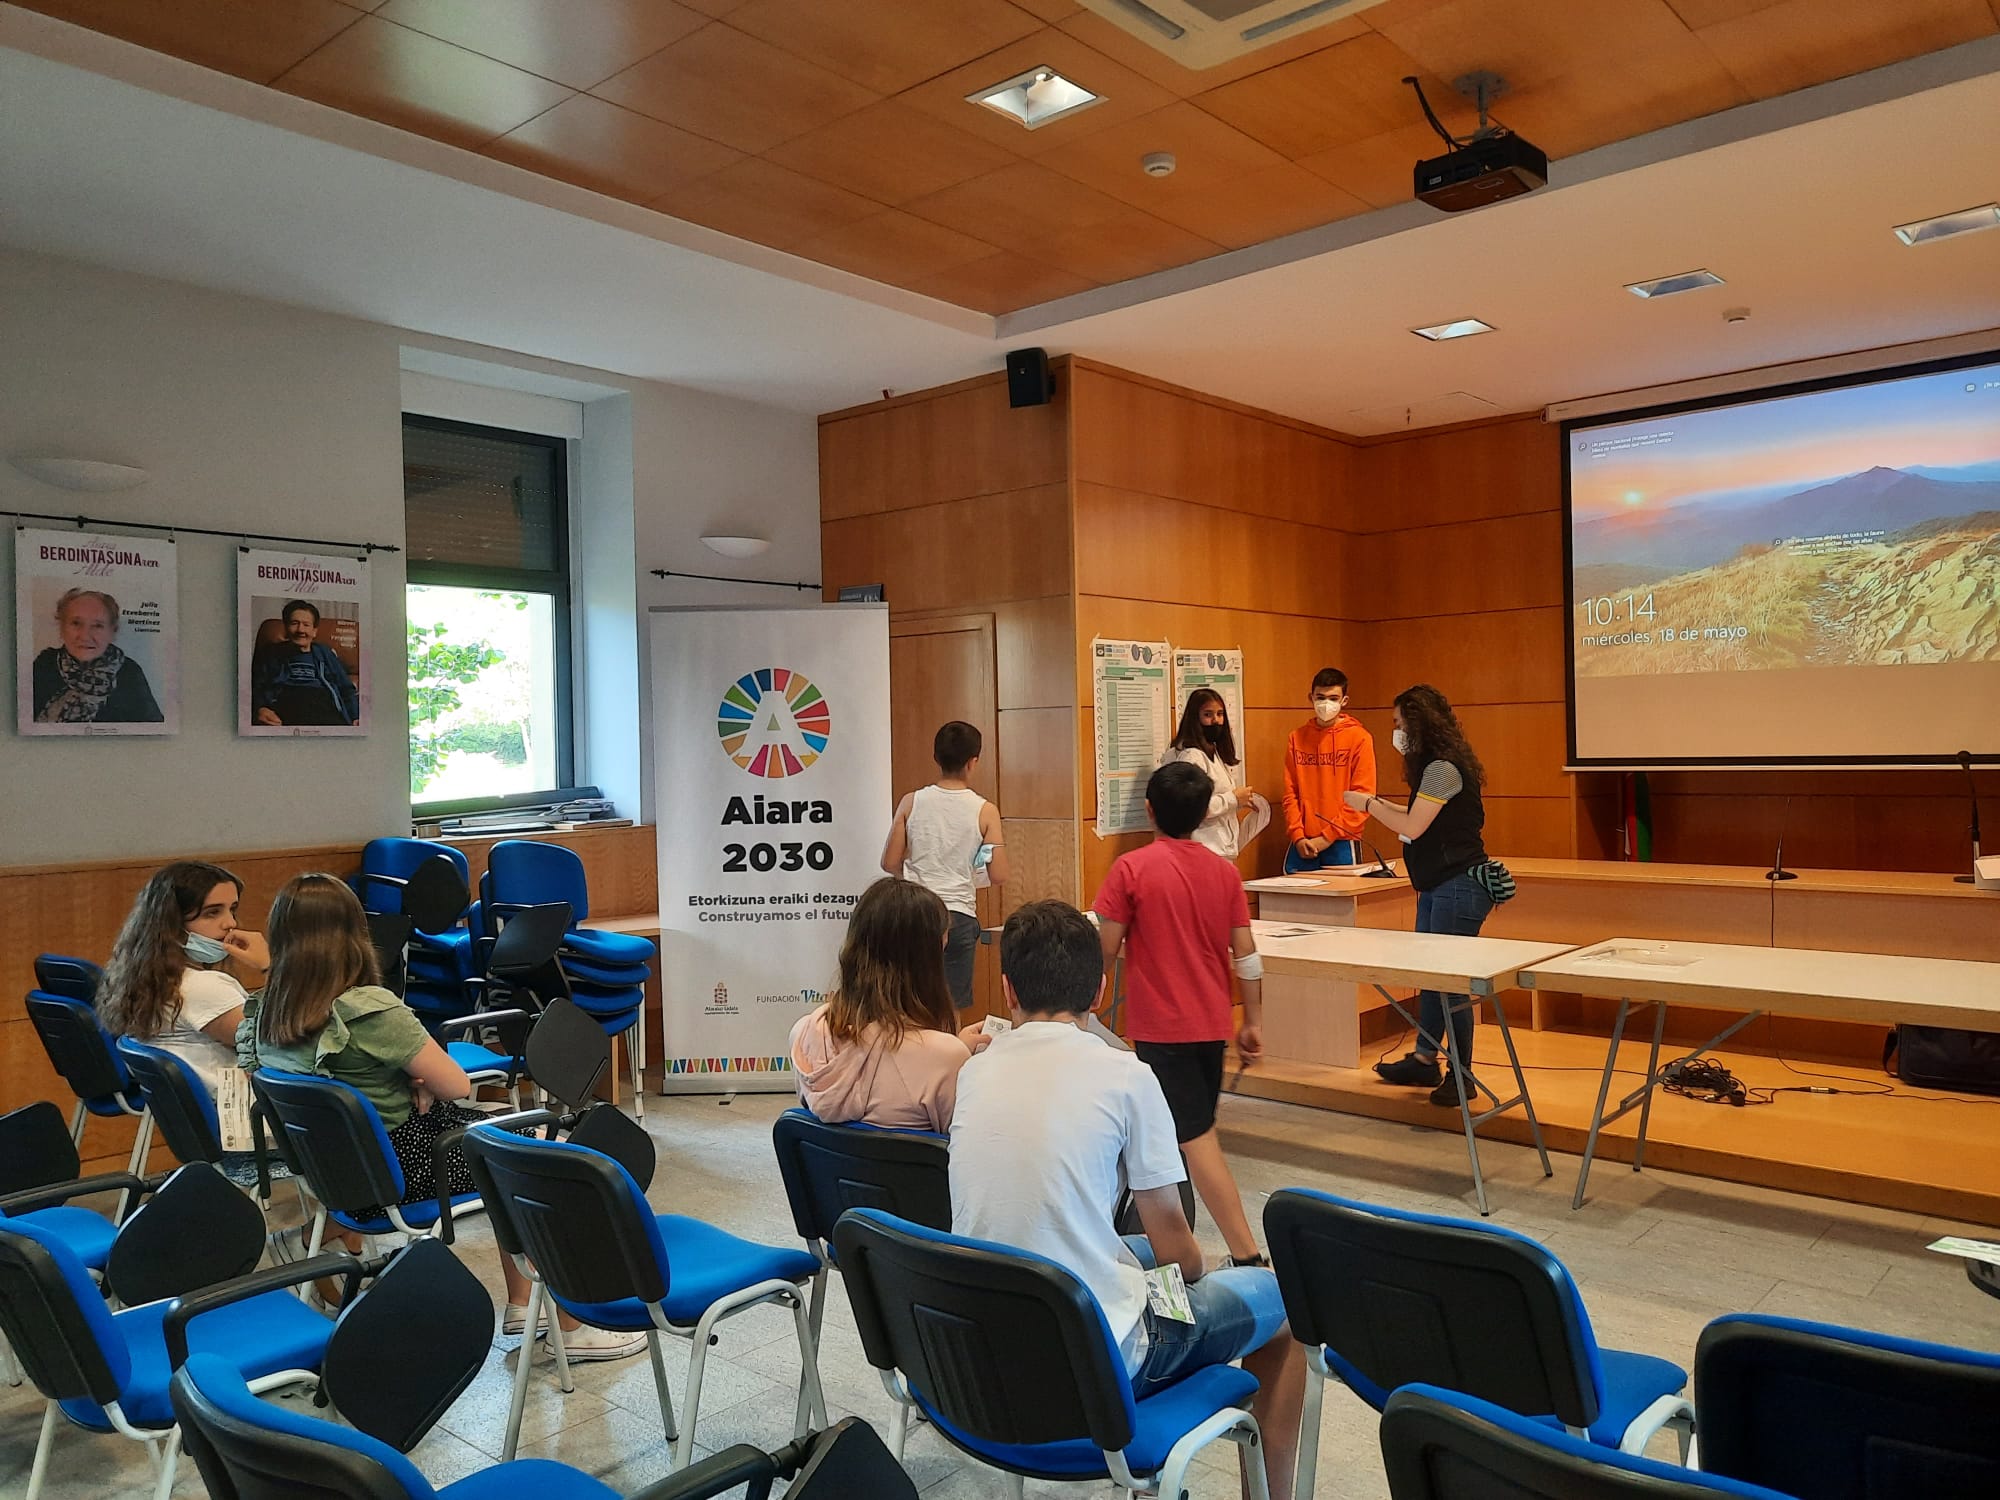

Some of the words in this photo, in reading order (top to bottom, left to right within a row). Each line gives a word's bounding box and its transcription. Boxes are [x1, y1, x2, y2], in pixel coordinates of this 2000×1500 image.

[1581, 593, 1657, 626] 10:14
[1582, 630, 1653, 647] miércoles,
[1659, 628, 1675, 642] 18
[1679, 626, 1698, 641] de
[1704, 625, 1748, 642] mayo
[720, 795, 833, 825] Aiara
[722, 841, 834, 873] 2030
[688, 894, 766, 906] Etorkizuna
[769, 893, 809, 905] eraiki
[699, 910, 801, 924] Construyamos
[804, 908, 818, 920] el
[756, 993, 800, 1004] FUNDACIÓN
